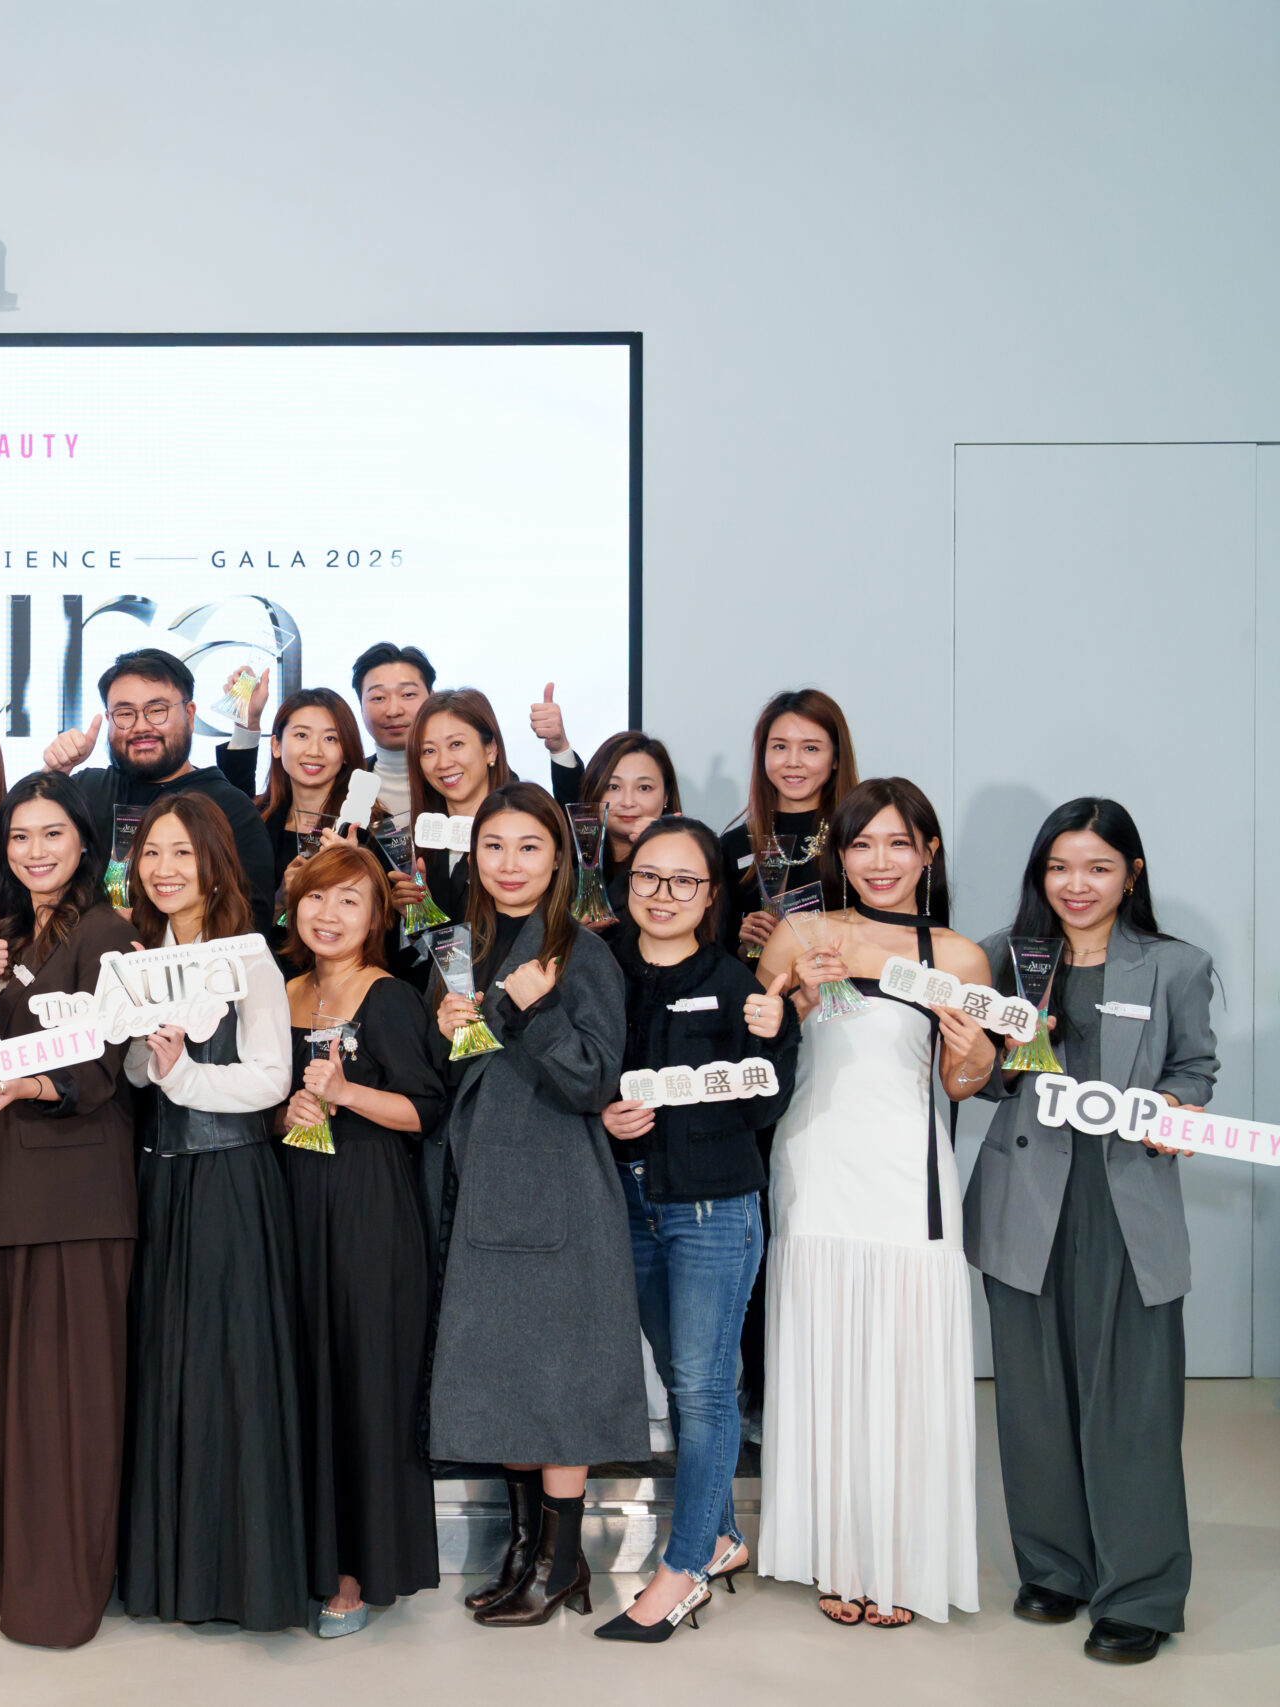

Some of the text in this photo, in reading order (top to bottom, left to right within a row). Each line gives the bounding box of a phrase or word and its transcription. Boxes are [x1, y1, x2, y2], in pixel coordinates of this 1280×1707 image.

[211, 549, 306, 569] GALA
[326, 549, 404, 569] 2025
[127, 950, 192, 967] EXPERIENCE
[37, 957, 240, 1021] The Aura
[888, 963, 1029, 1034] 體驗盛典
[0, 1027, 99, 1073] BEAUTY
[627, 1065, 769, 1101] 體驗盛典
[1045, 1082, 1280, 1158] TOP BEAUTY
